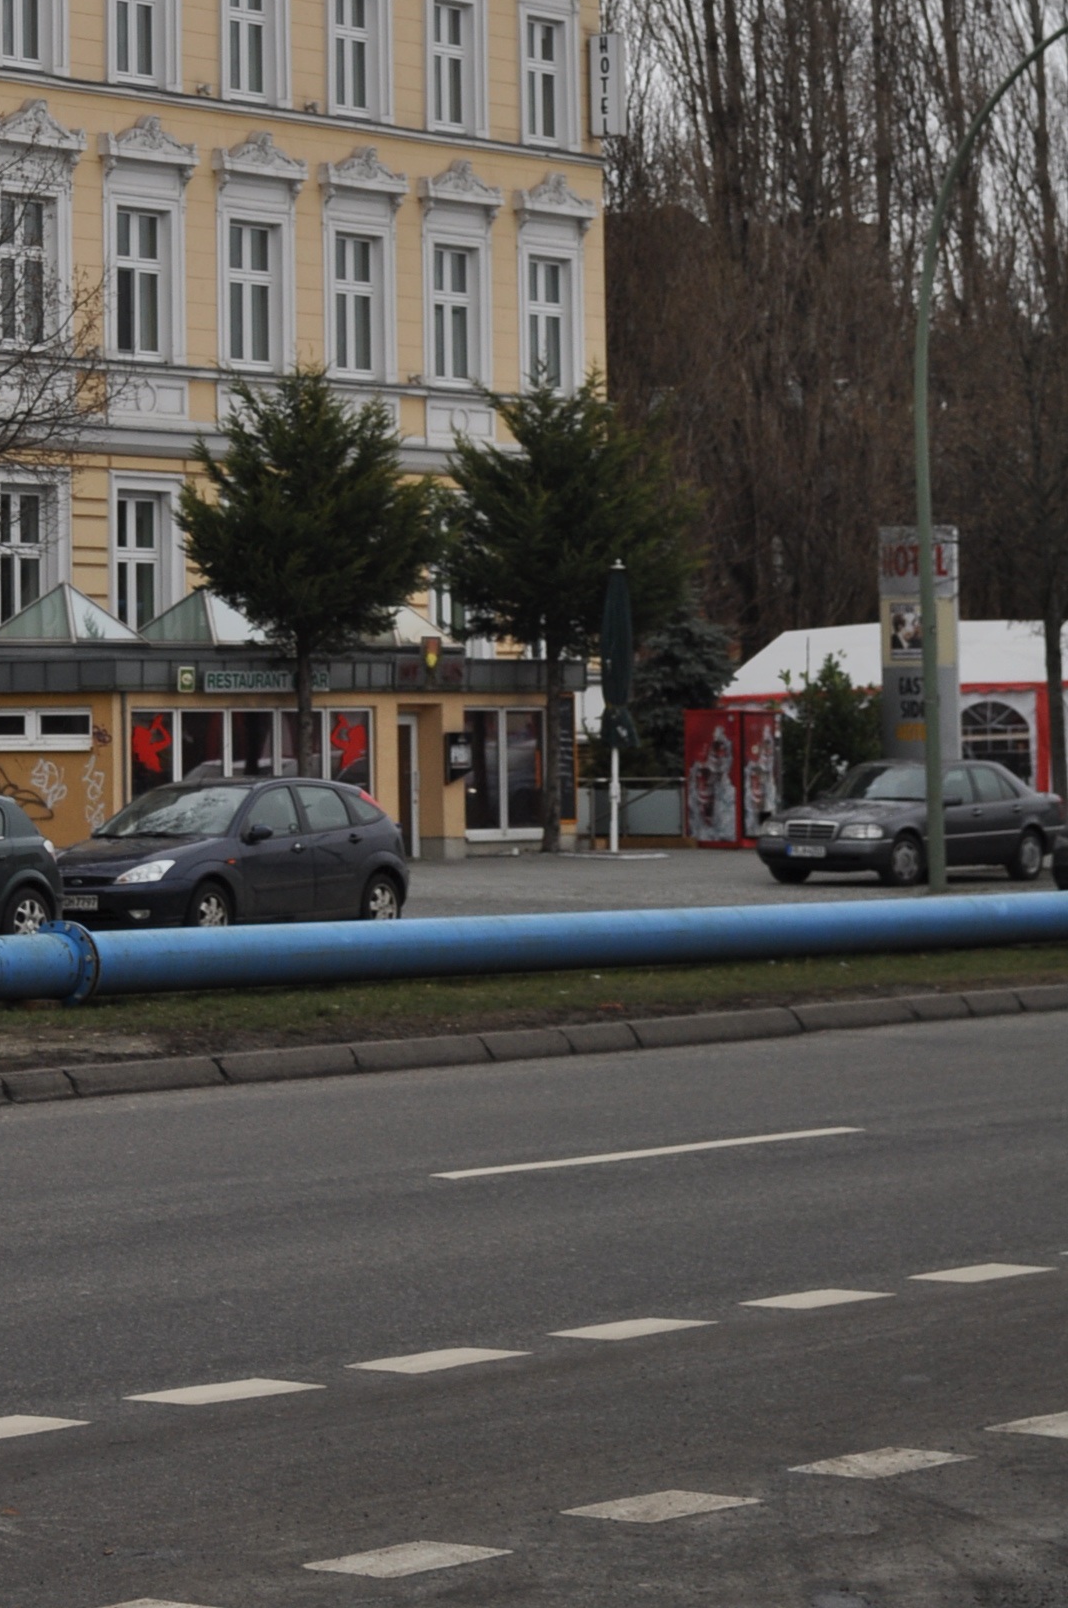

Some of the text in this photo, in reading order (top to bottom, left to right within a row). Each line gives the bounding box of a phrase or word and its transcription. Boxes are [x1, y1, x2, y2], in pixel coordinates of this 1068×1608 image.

[599, 36, 610, 136] HOTEL
[882, 542, 949, 578] HOTL
[206, 672, 289, 689] RESTAURANT
